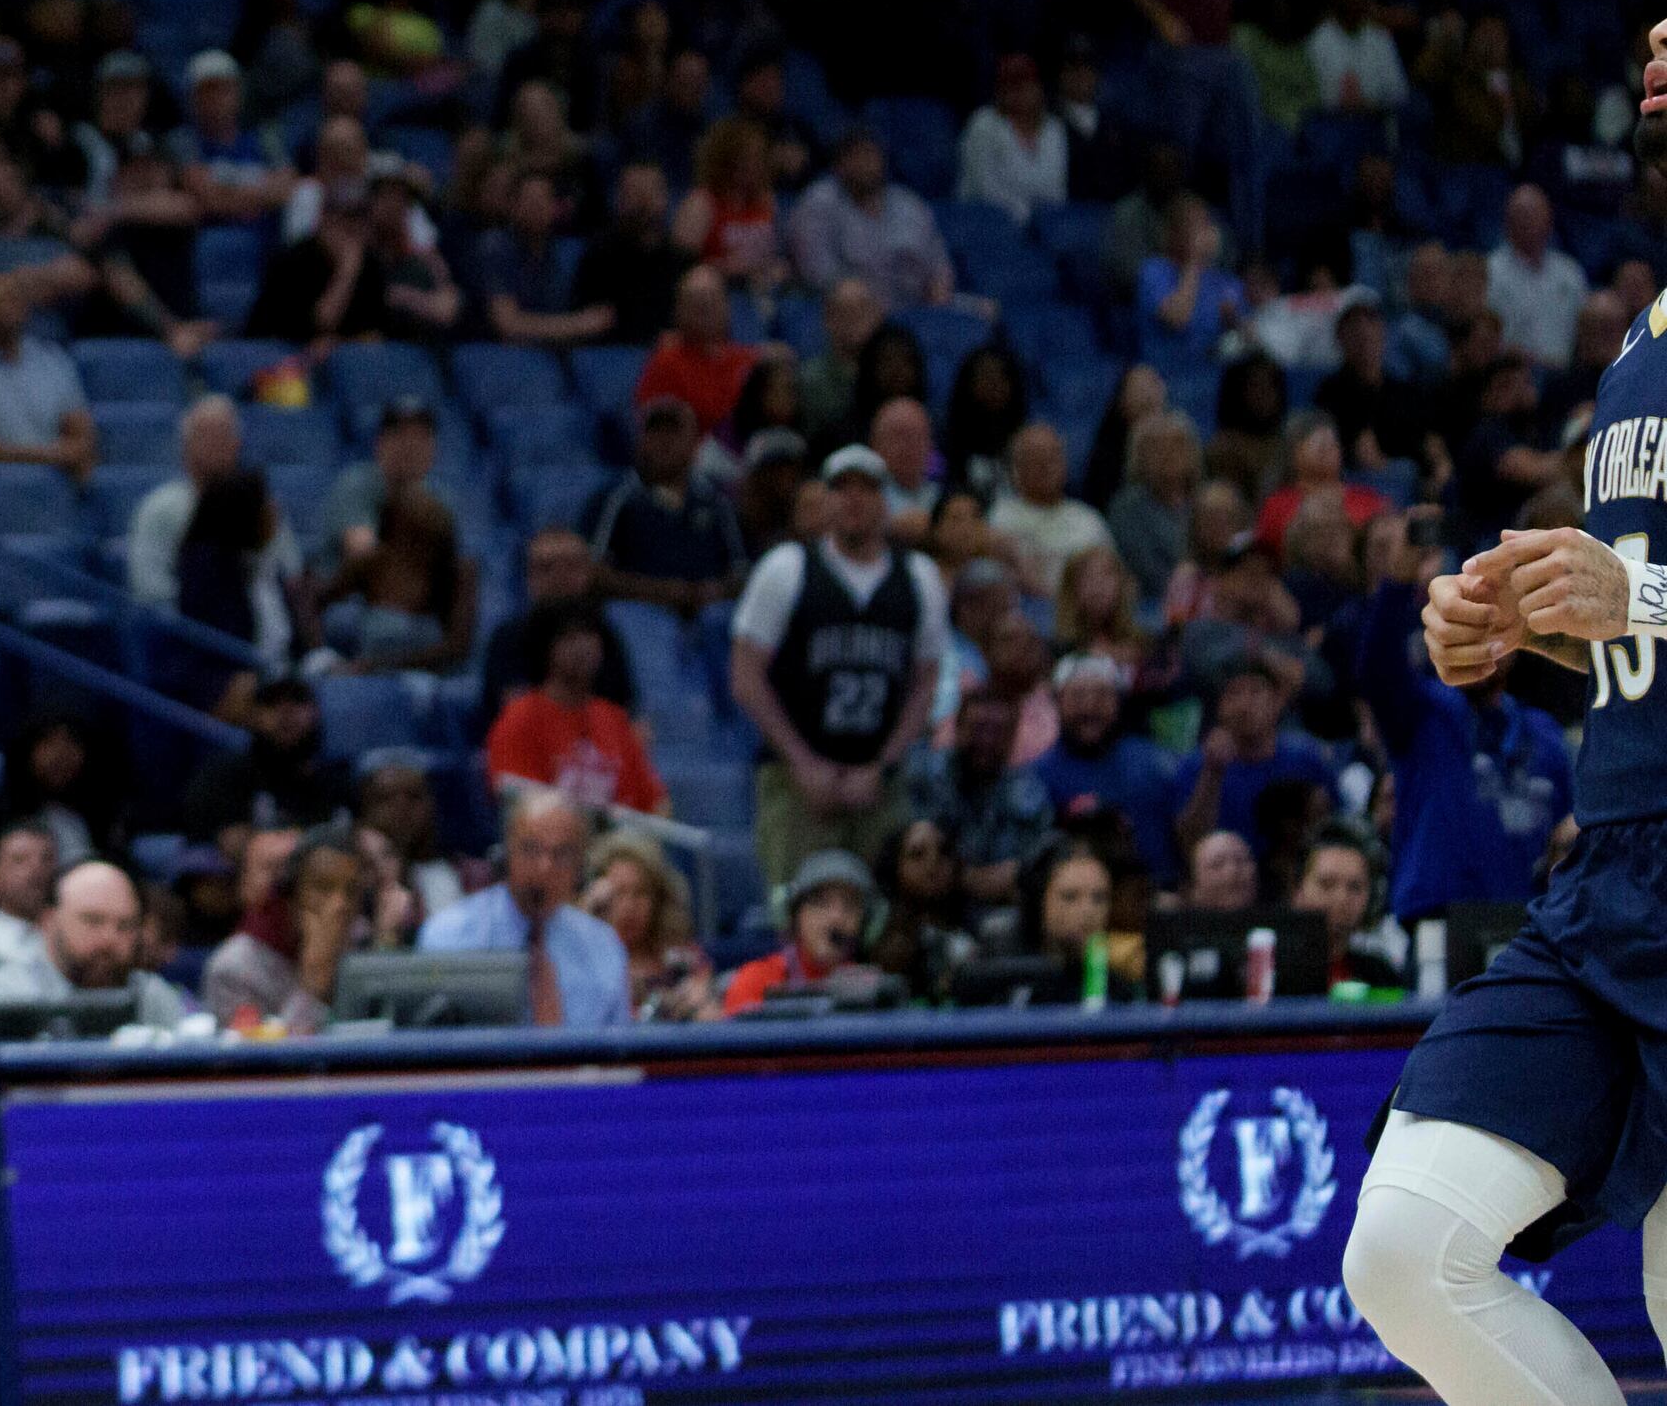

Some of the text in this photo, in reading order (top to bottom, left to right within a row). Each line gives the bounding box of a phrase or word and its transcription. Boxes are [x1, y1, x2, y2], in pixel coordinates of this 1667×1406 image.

[385, 1153, 452, 1263] F
[116, 1316, 752, 1402] FRIEND & COMPANY
[1000, 1291, 1223, 1357] FRIEND
[1232, 1286, 1278, 1340] &
